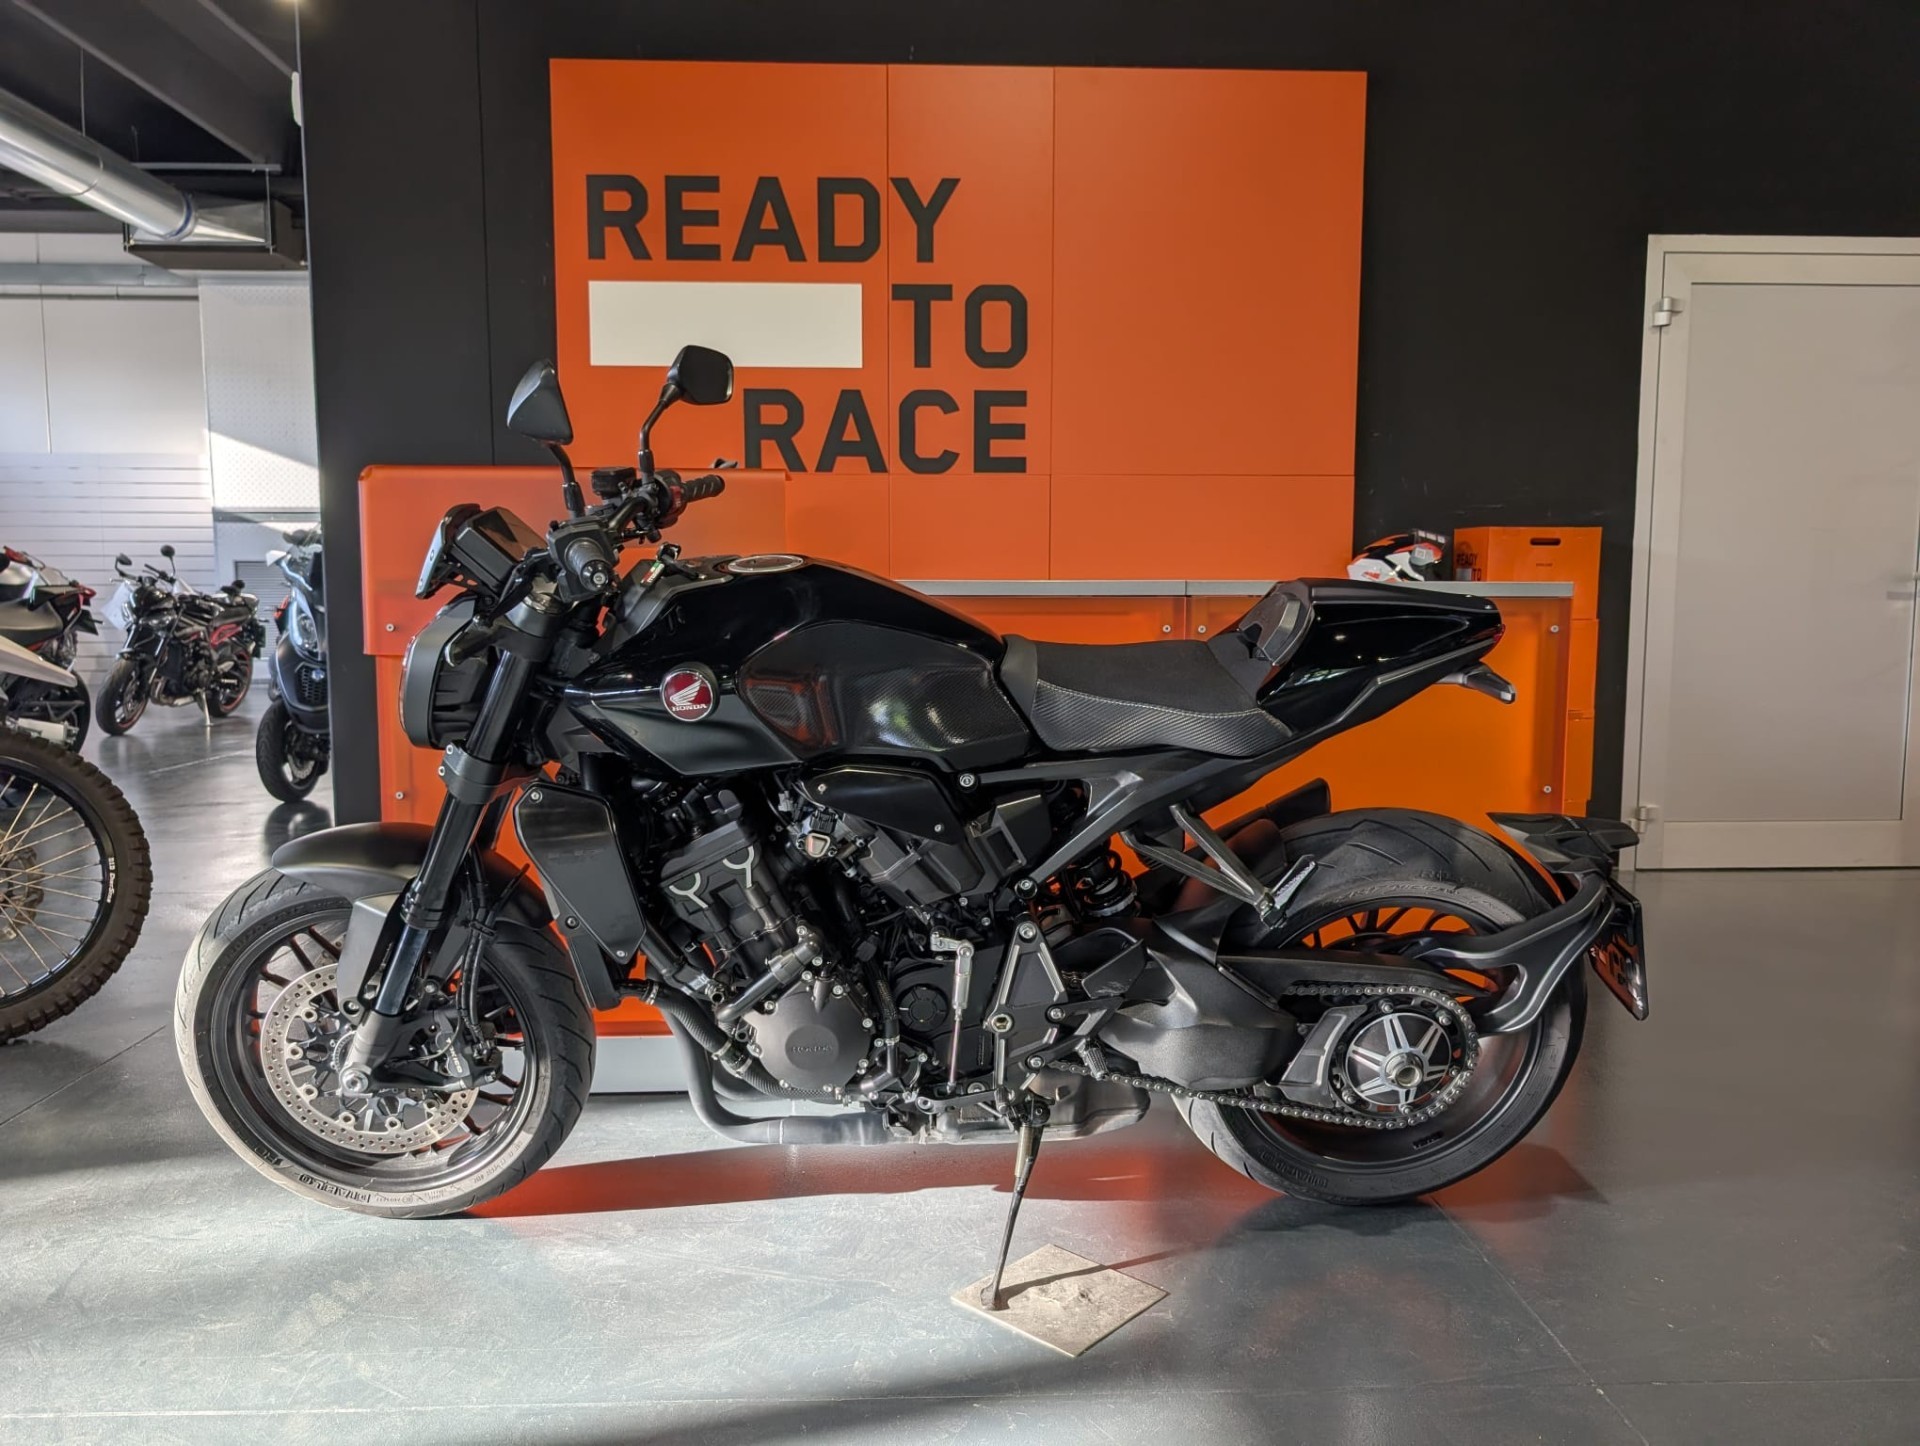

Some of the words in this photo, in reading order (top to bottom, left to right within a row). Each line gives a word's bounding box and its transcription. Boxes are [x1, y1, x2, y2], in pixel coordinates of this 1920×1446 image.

[586, 174, 961, 264] READY
[891, 283, 1028, 369] TO
[743, 388, 1028, 474] RACE
[1456, 552, 1479, 567] READY
[672, 703, 708, 712] HONDA
[298, 1173, 371, 1203] DIABLO
